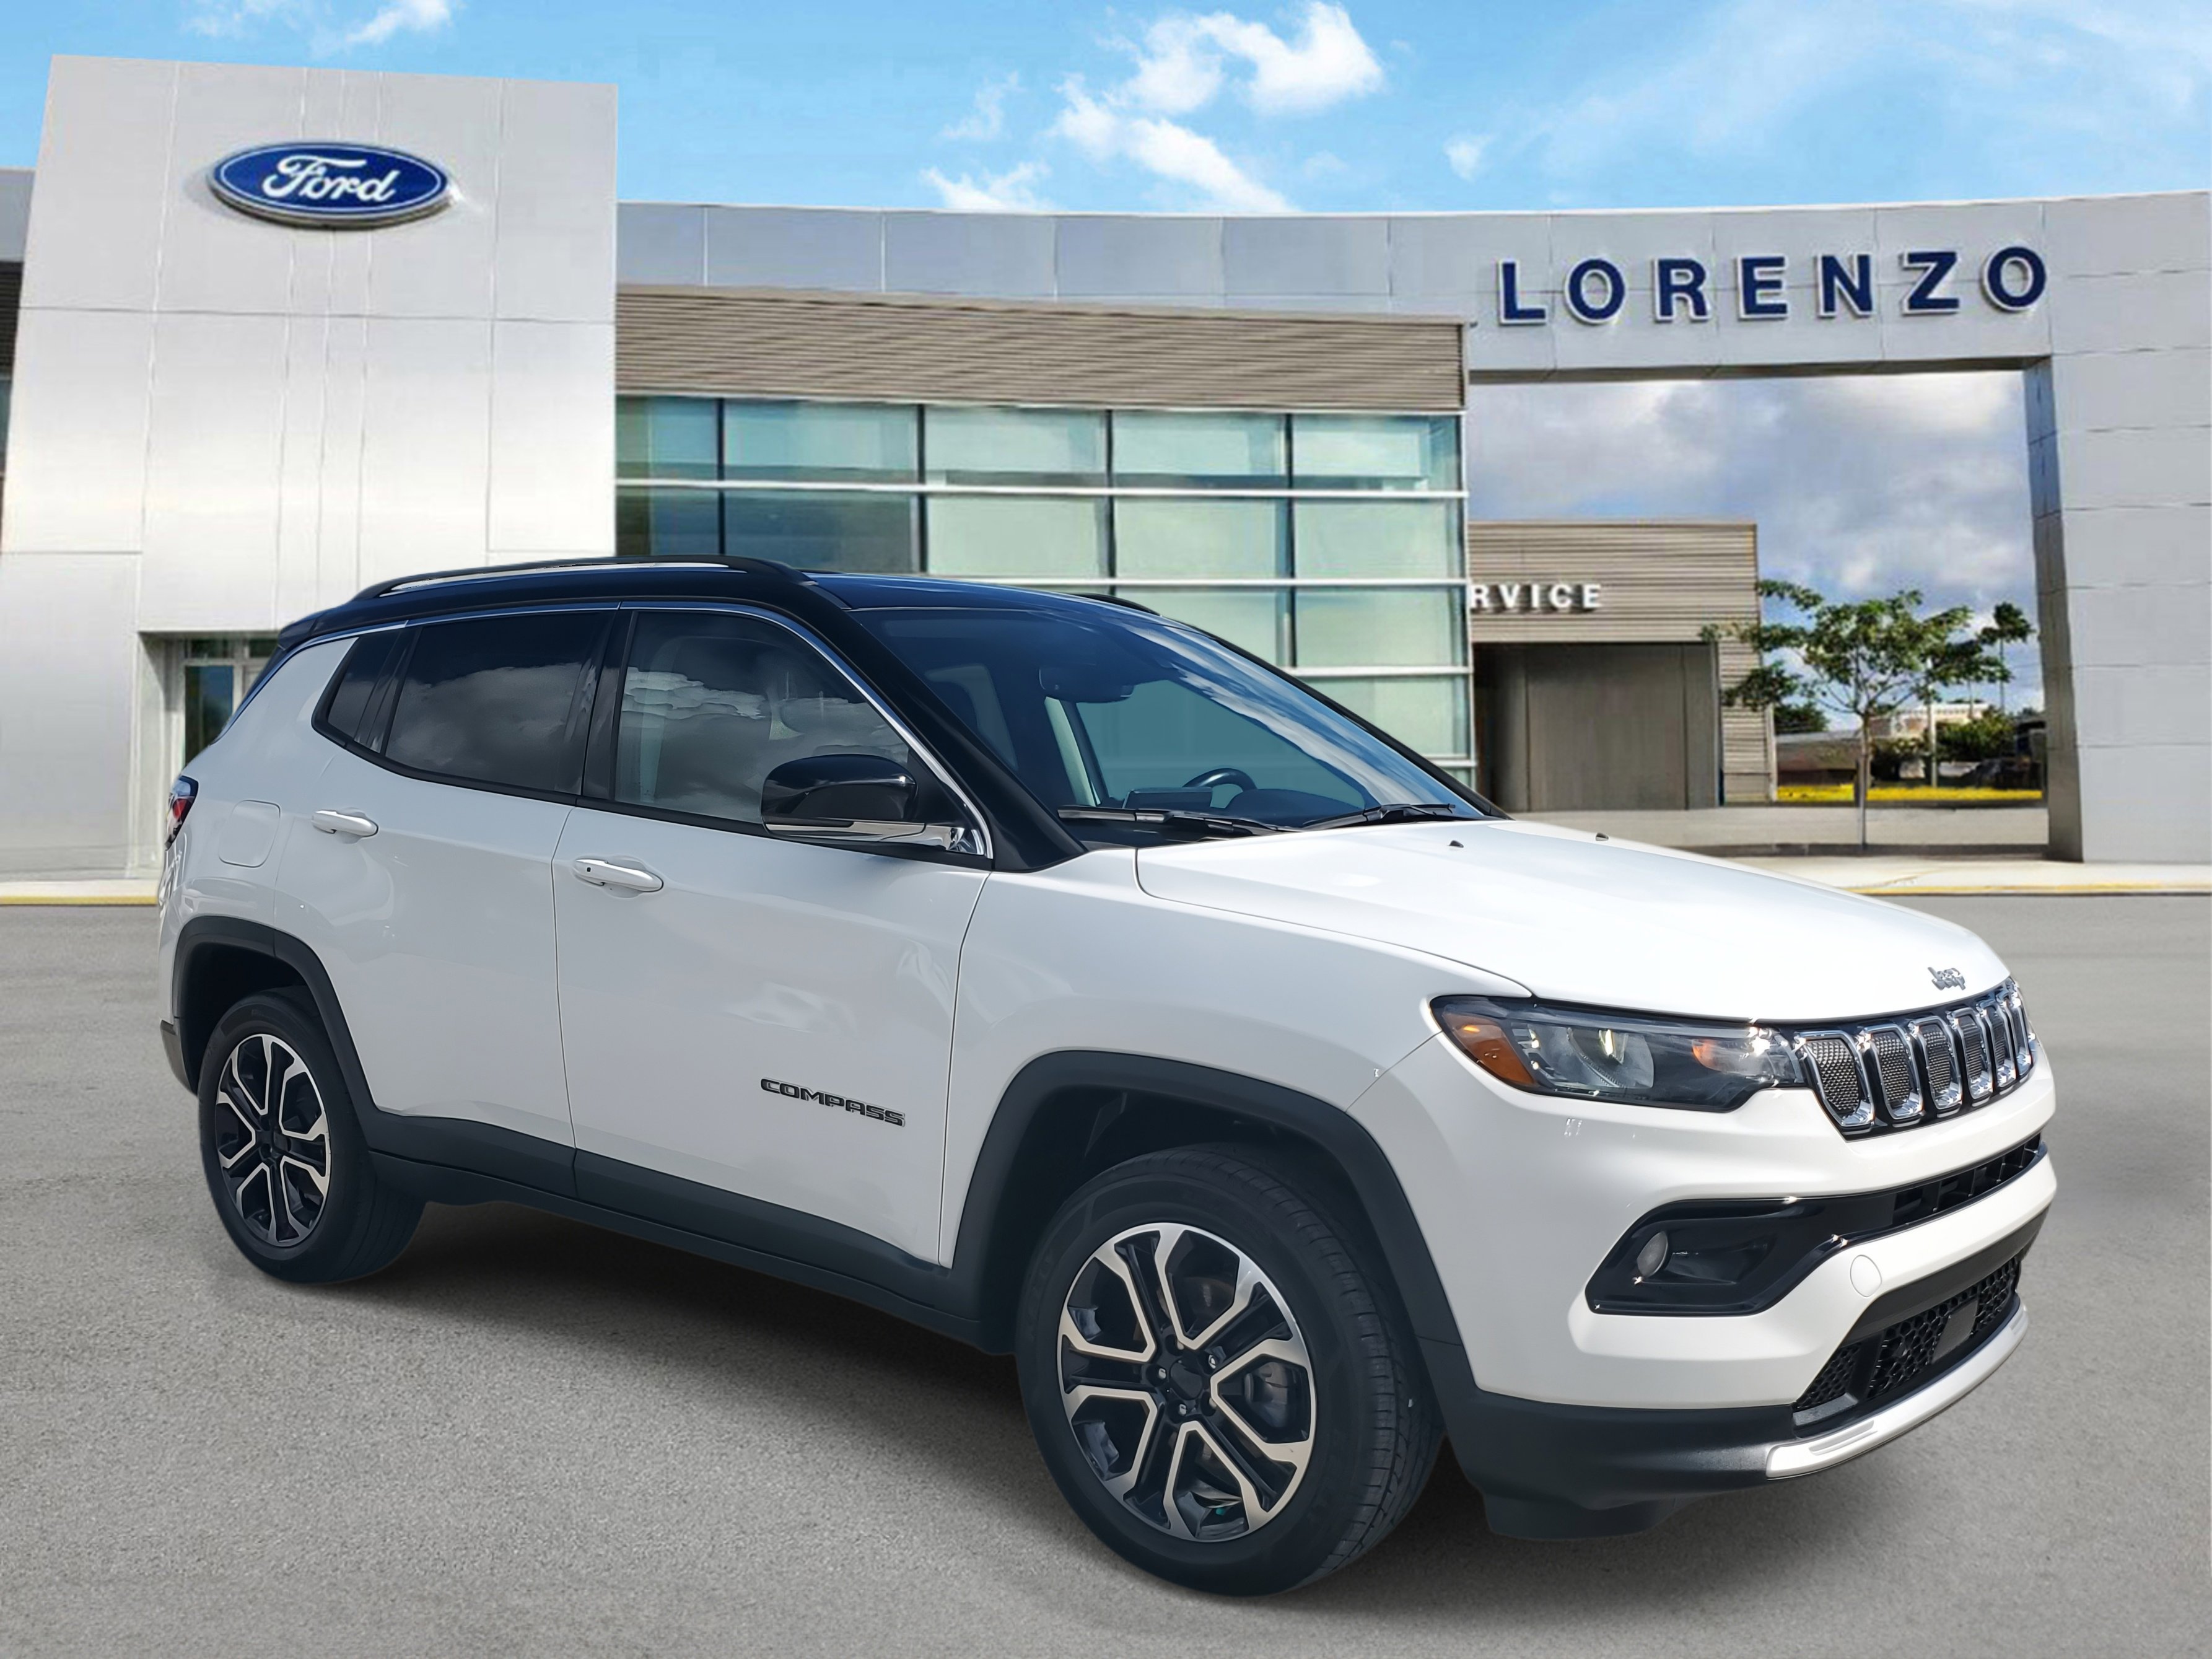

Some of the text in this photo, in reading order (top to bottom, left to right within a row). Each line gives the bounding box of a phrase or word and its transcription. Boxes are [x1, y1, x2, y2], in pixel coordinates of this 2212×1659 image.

[262, 155, 401, 202] Ford
[1499, 246, 2047, 323] LORENZO
[1927, 966, 1966, 991] Jeep
[761, 1078, 906, 1127] COMPASS
